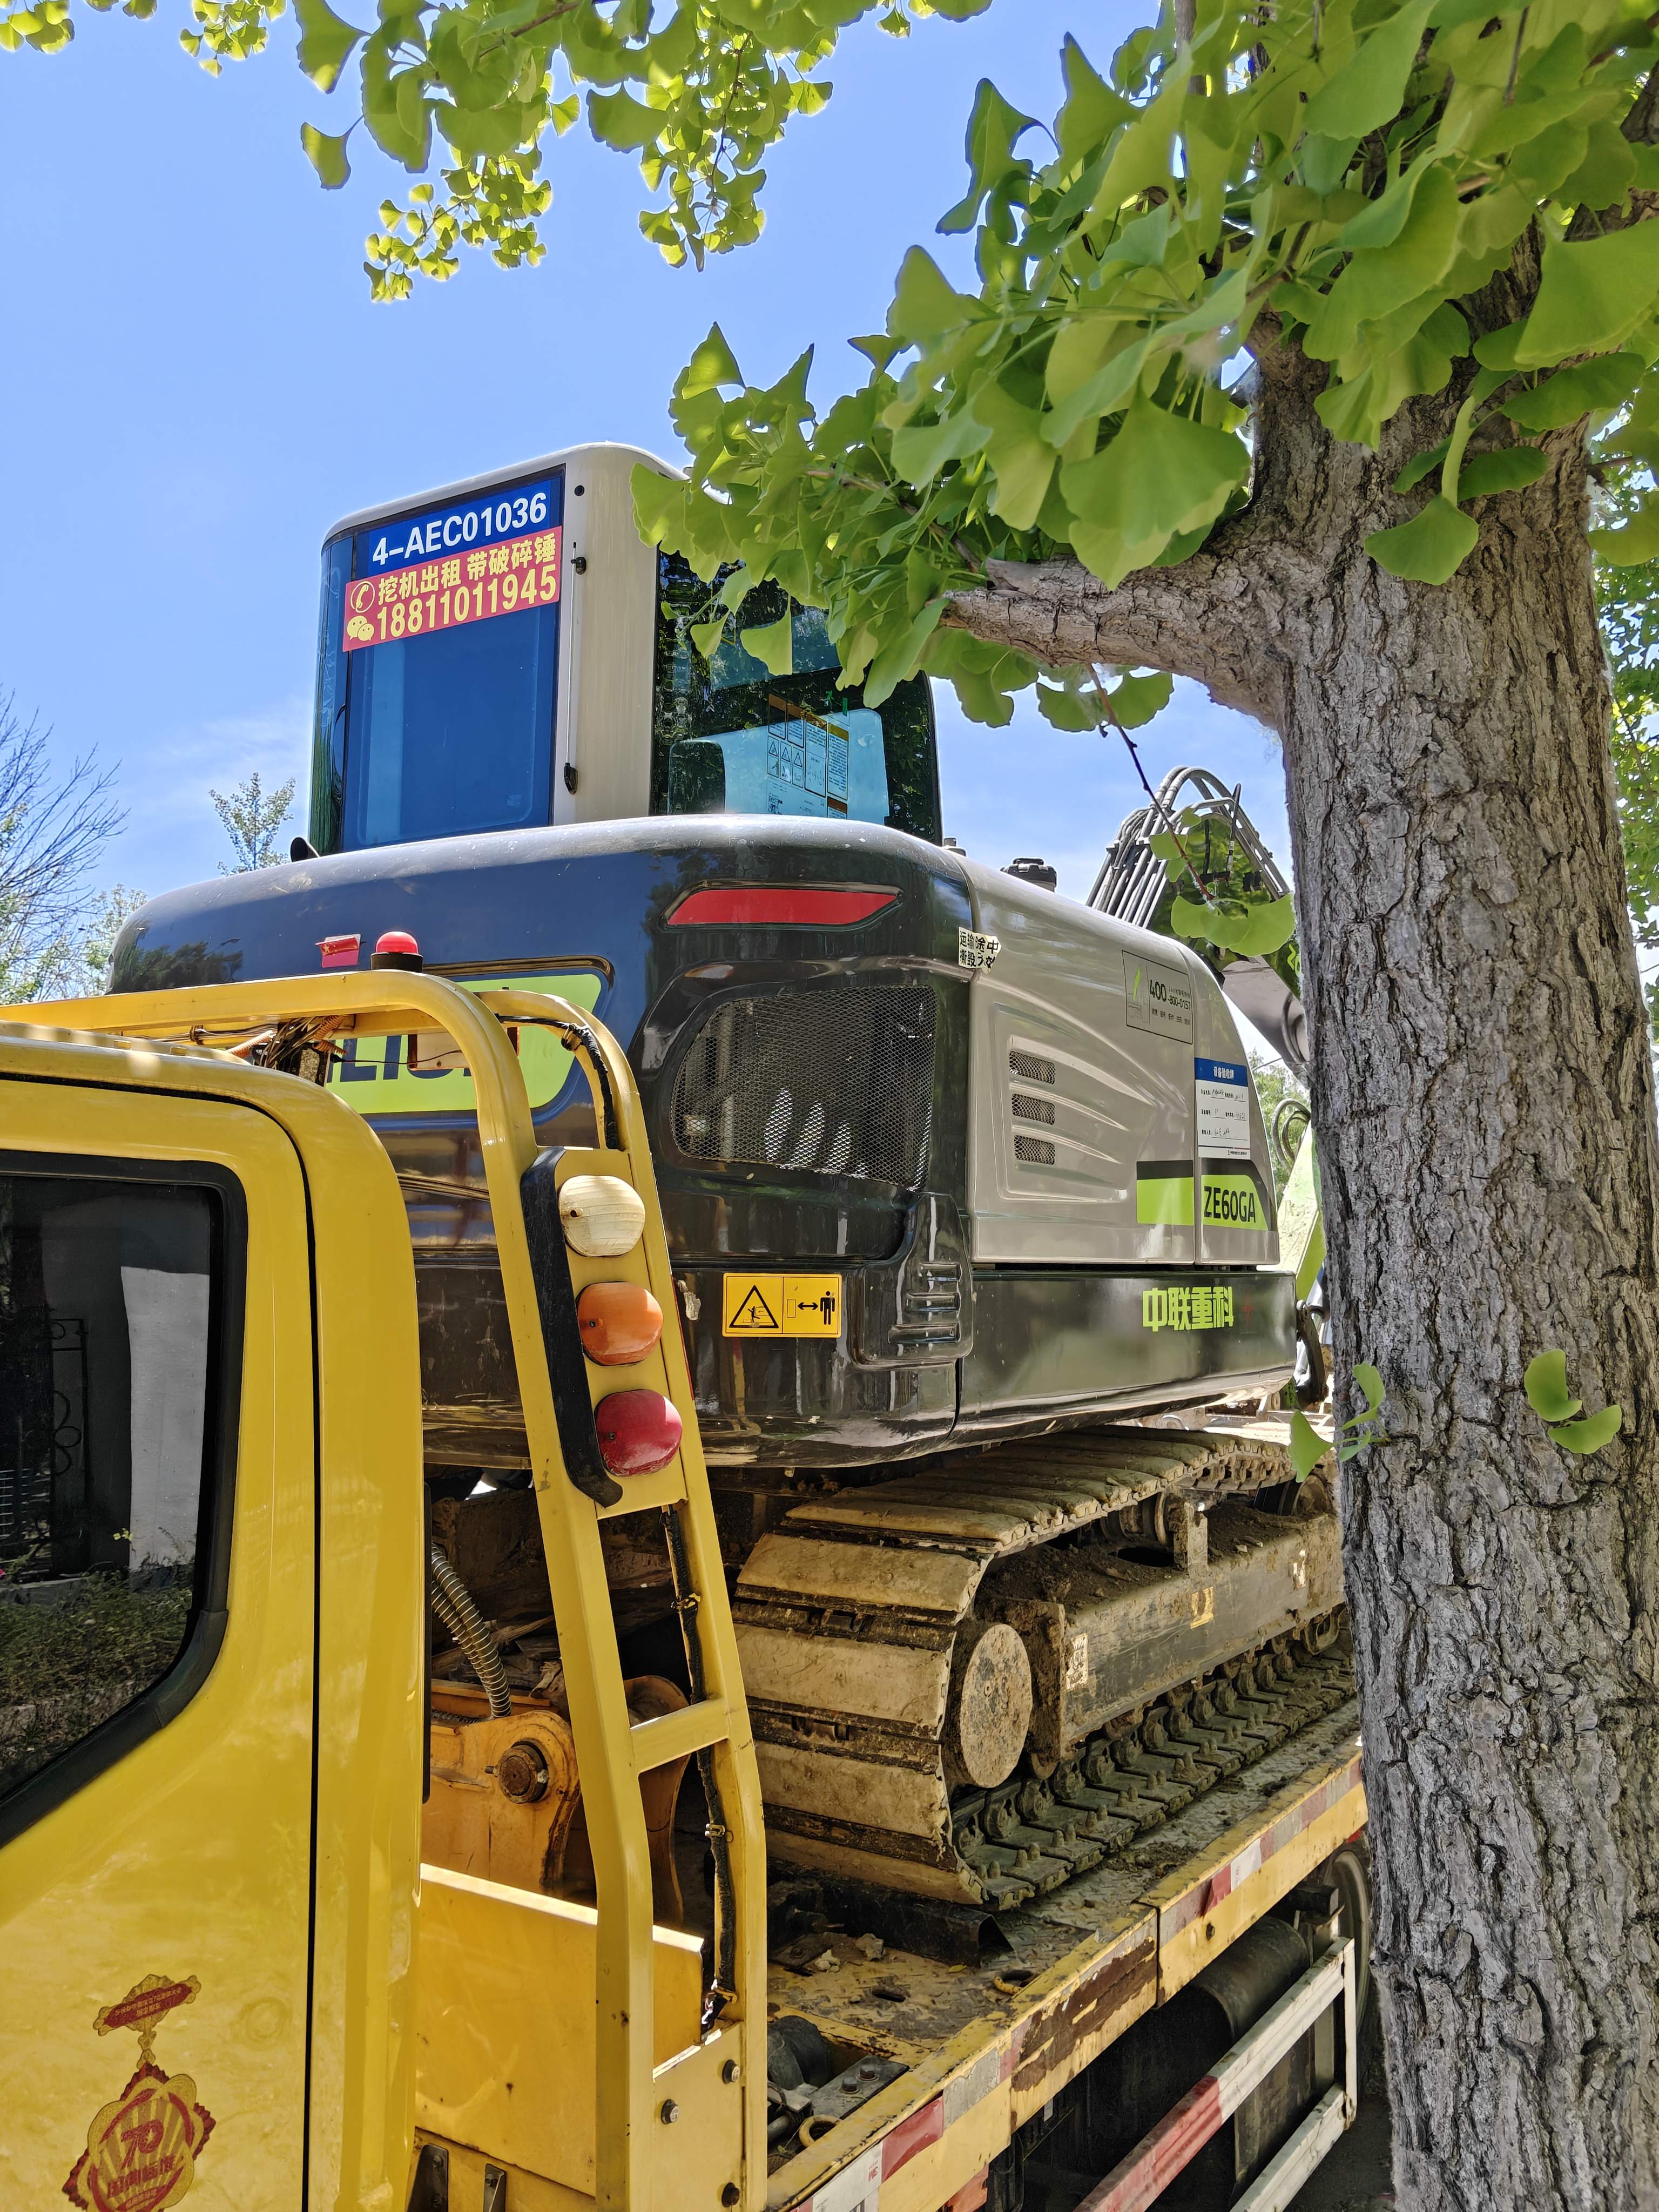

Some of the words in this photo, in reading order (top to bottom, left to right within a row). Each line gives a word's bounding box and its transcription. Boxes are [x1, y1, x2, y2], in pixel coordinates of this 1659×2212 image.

[373, 492, 547, 565] 4-AEC01036
[378, 558, 462, 605] 挖机出租
[467, 534, 556, 581] 带破碎锤
[377, 564, 557, 640] 18811011945
[960, 930, 999, 954] 运输途中
[1204, 1186, 1256, 1223] ZE60GA
[1142, 1286, 1235, 1332] 中联重科
